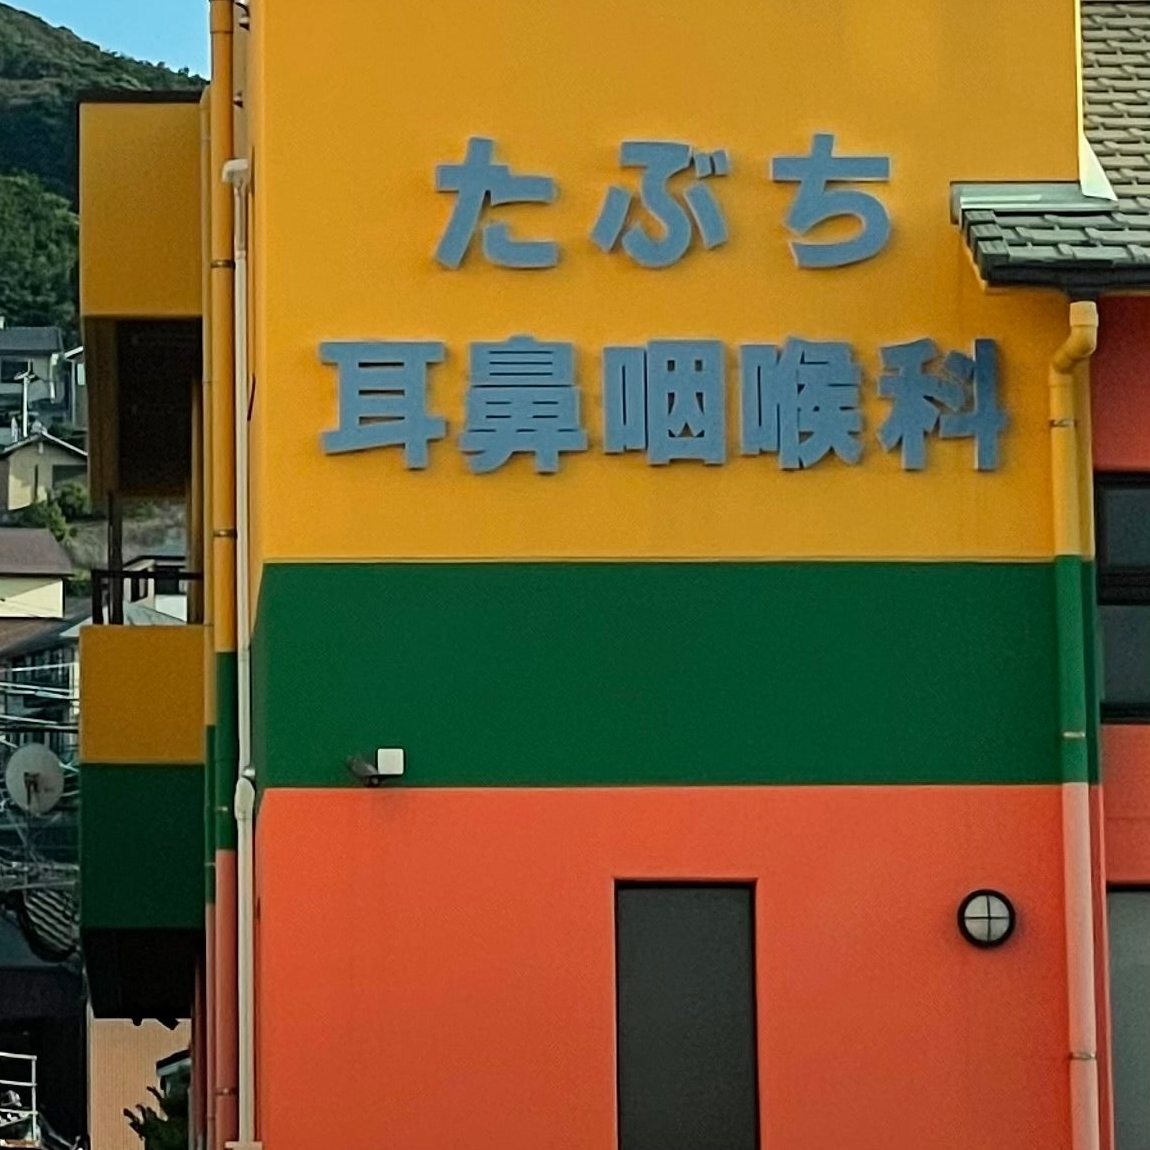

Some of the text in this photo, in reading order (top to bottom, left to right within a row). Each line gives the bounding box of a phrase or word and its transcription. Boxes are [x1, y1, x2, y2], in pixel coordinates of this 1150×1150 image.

[433, 133, 891, 270] たぶち
[318, 335, 1008, 473] 耳鼻咽喉科
